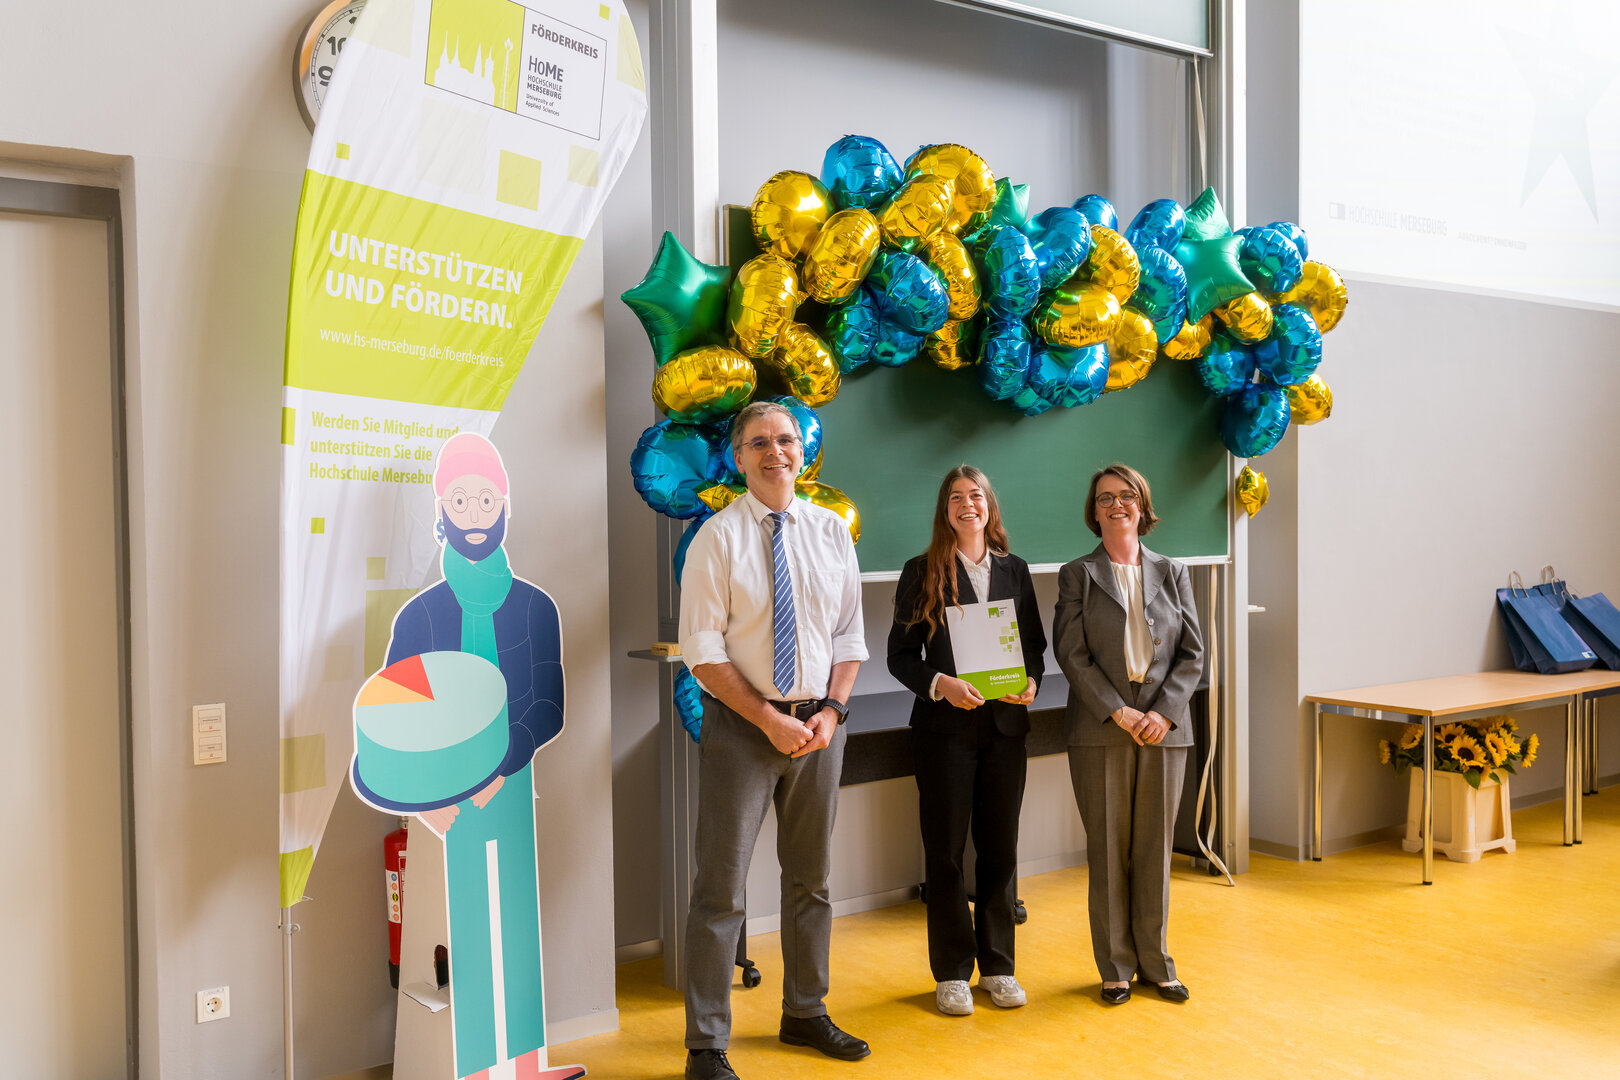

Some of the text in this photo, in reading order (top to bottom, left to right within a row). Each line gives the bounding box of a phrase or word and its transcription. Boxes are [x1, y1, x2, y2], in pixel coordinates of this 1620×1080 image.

[531, 23, 599, 59] FÖRDERKREIS
[528, 55, 564, 83] HoME
[526, 82, 562, 100] MERSEBURG
[527, 74, 562, 92] HOCHSCHULE
[525, 93, 548, 106] University
[525, 100, 560, 117] Applied Sciences
[1349, 204, 1448, 237] HOCHSCHULE MERSEBURG
[329, 229, 523, 295] UNTERSTÜTZEN
[325, 269, 513, 330] UND FÖRDERN.
[319, 327, 504, 368] www.hs-merseburg.de/foerderkreis
[311, 410, 359, 431] Werden
[362, 416, 381, 433] Sie
[383, 418, 434, 440] Mitglied
[310, 439, 433, 461] unterstützen Sie die
[309, 462, 379, 482] Hochschule
[989, 672, 1020, 681] Förderkreis
